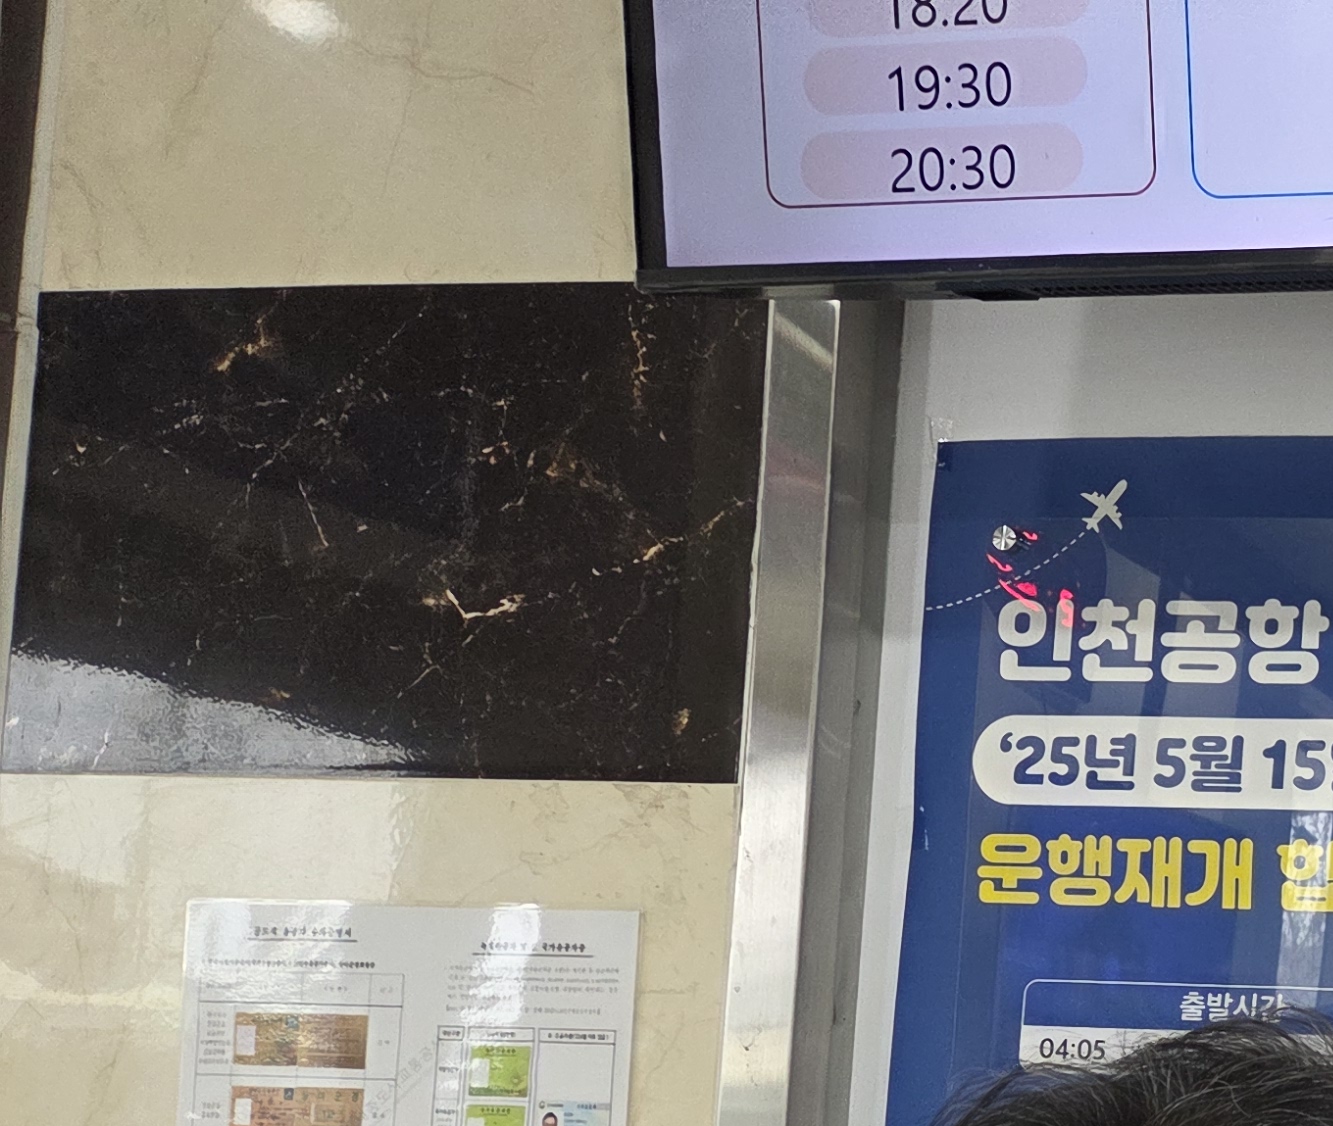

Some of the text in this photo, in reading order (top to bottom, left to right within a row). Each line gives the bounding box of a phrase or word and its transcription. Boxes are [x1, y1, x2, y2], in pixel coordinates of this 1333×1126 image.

[888, 61, 1012, 112] 19:30
[890, 143, 1016, 194] 20:30
[997, 597, 1330, 684] 인천공항
[1153, 734, 1245, 793] 5월
[977, 833, 1254, 910] 운행재개
[1039, 1037, 1107, 1062] 04:05
